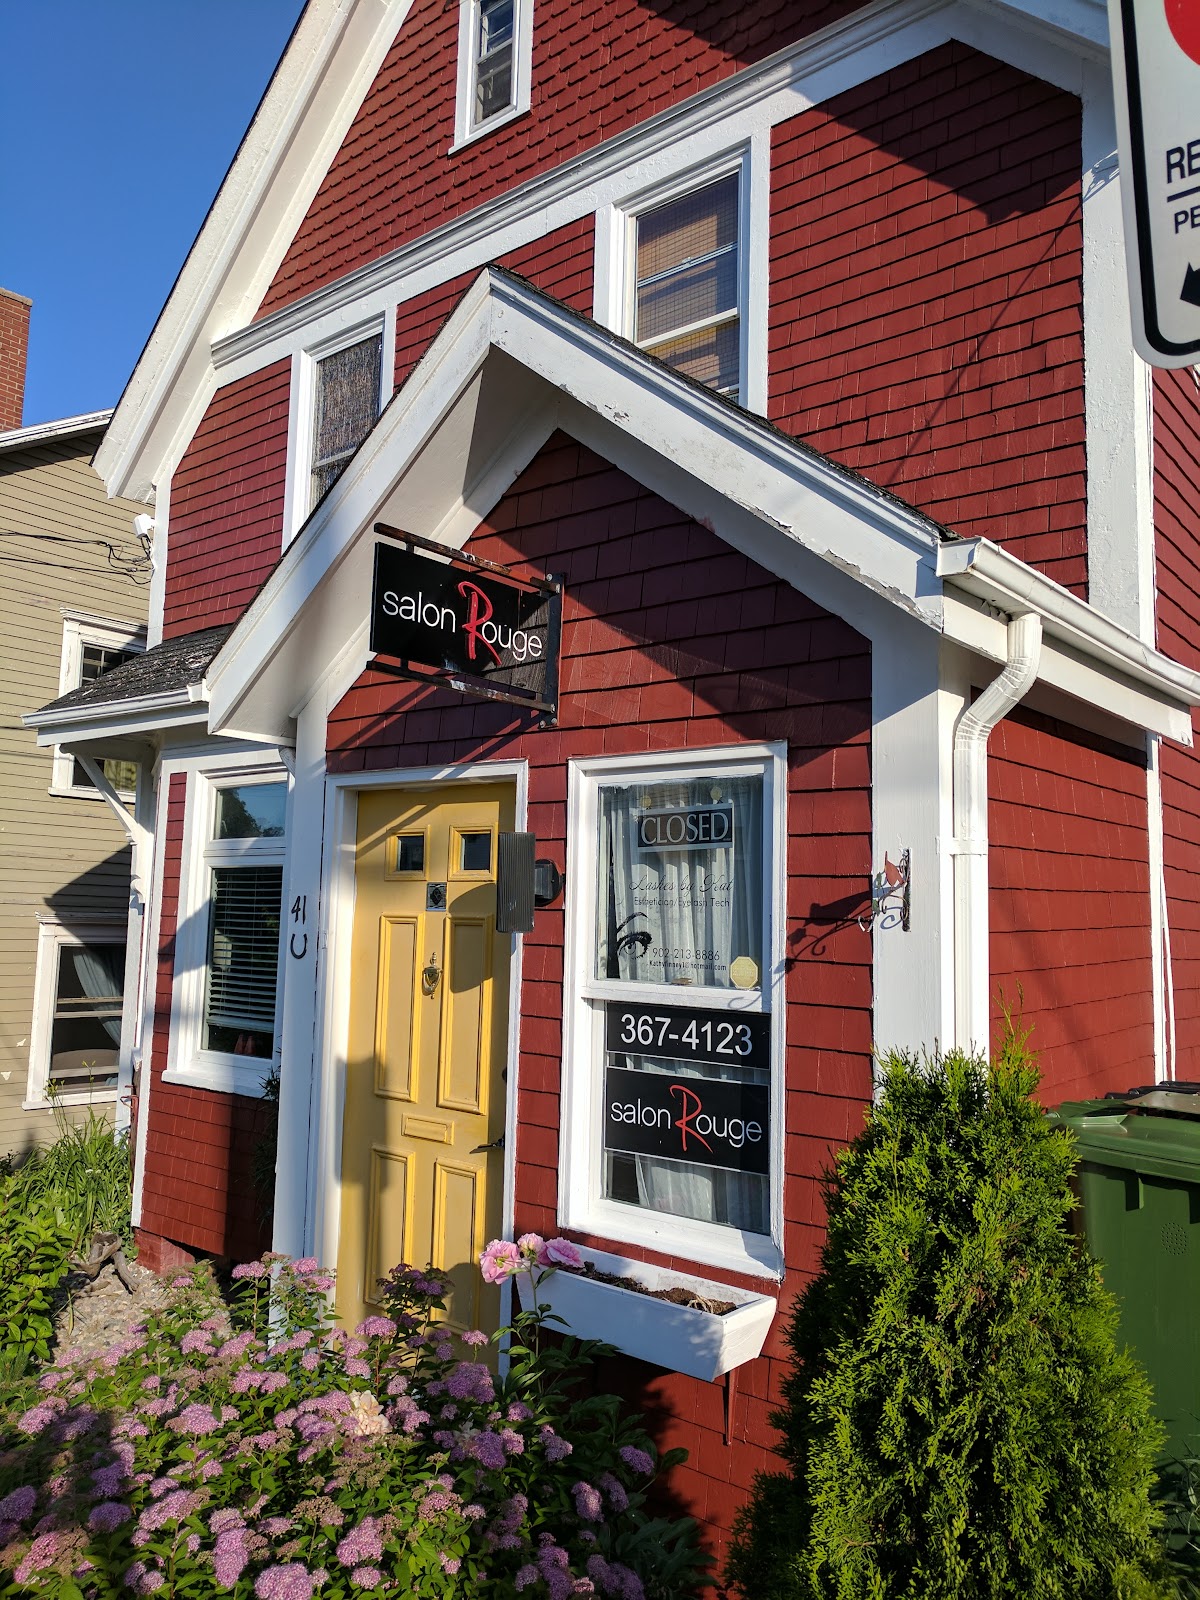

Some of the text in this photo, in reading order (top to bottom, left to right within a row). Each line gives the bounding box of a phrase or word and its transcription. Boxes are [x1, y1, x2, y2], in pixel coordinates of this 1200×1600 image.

[382, 581, 543, 666] salon Rouge
[640, 812, 729, 845] CLOSED
[629, 874, 676, 891] Lashes
[680, 875, 696, 897] by
[291, 895, 307, 925] 41
[710, 897, 730, 907] Tech
[652, 947, 720, 961] 902-213-8886
[620, 1013, 753, 1056] 367-4123
[610, 1085, 762, 1154] salon Rouge
